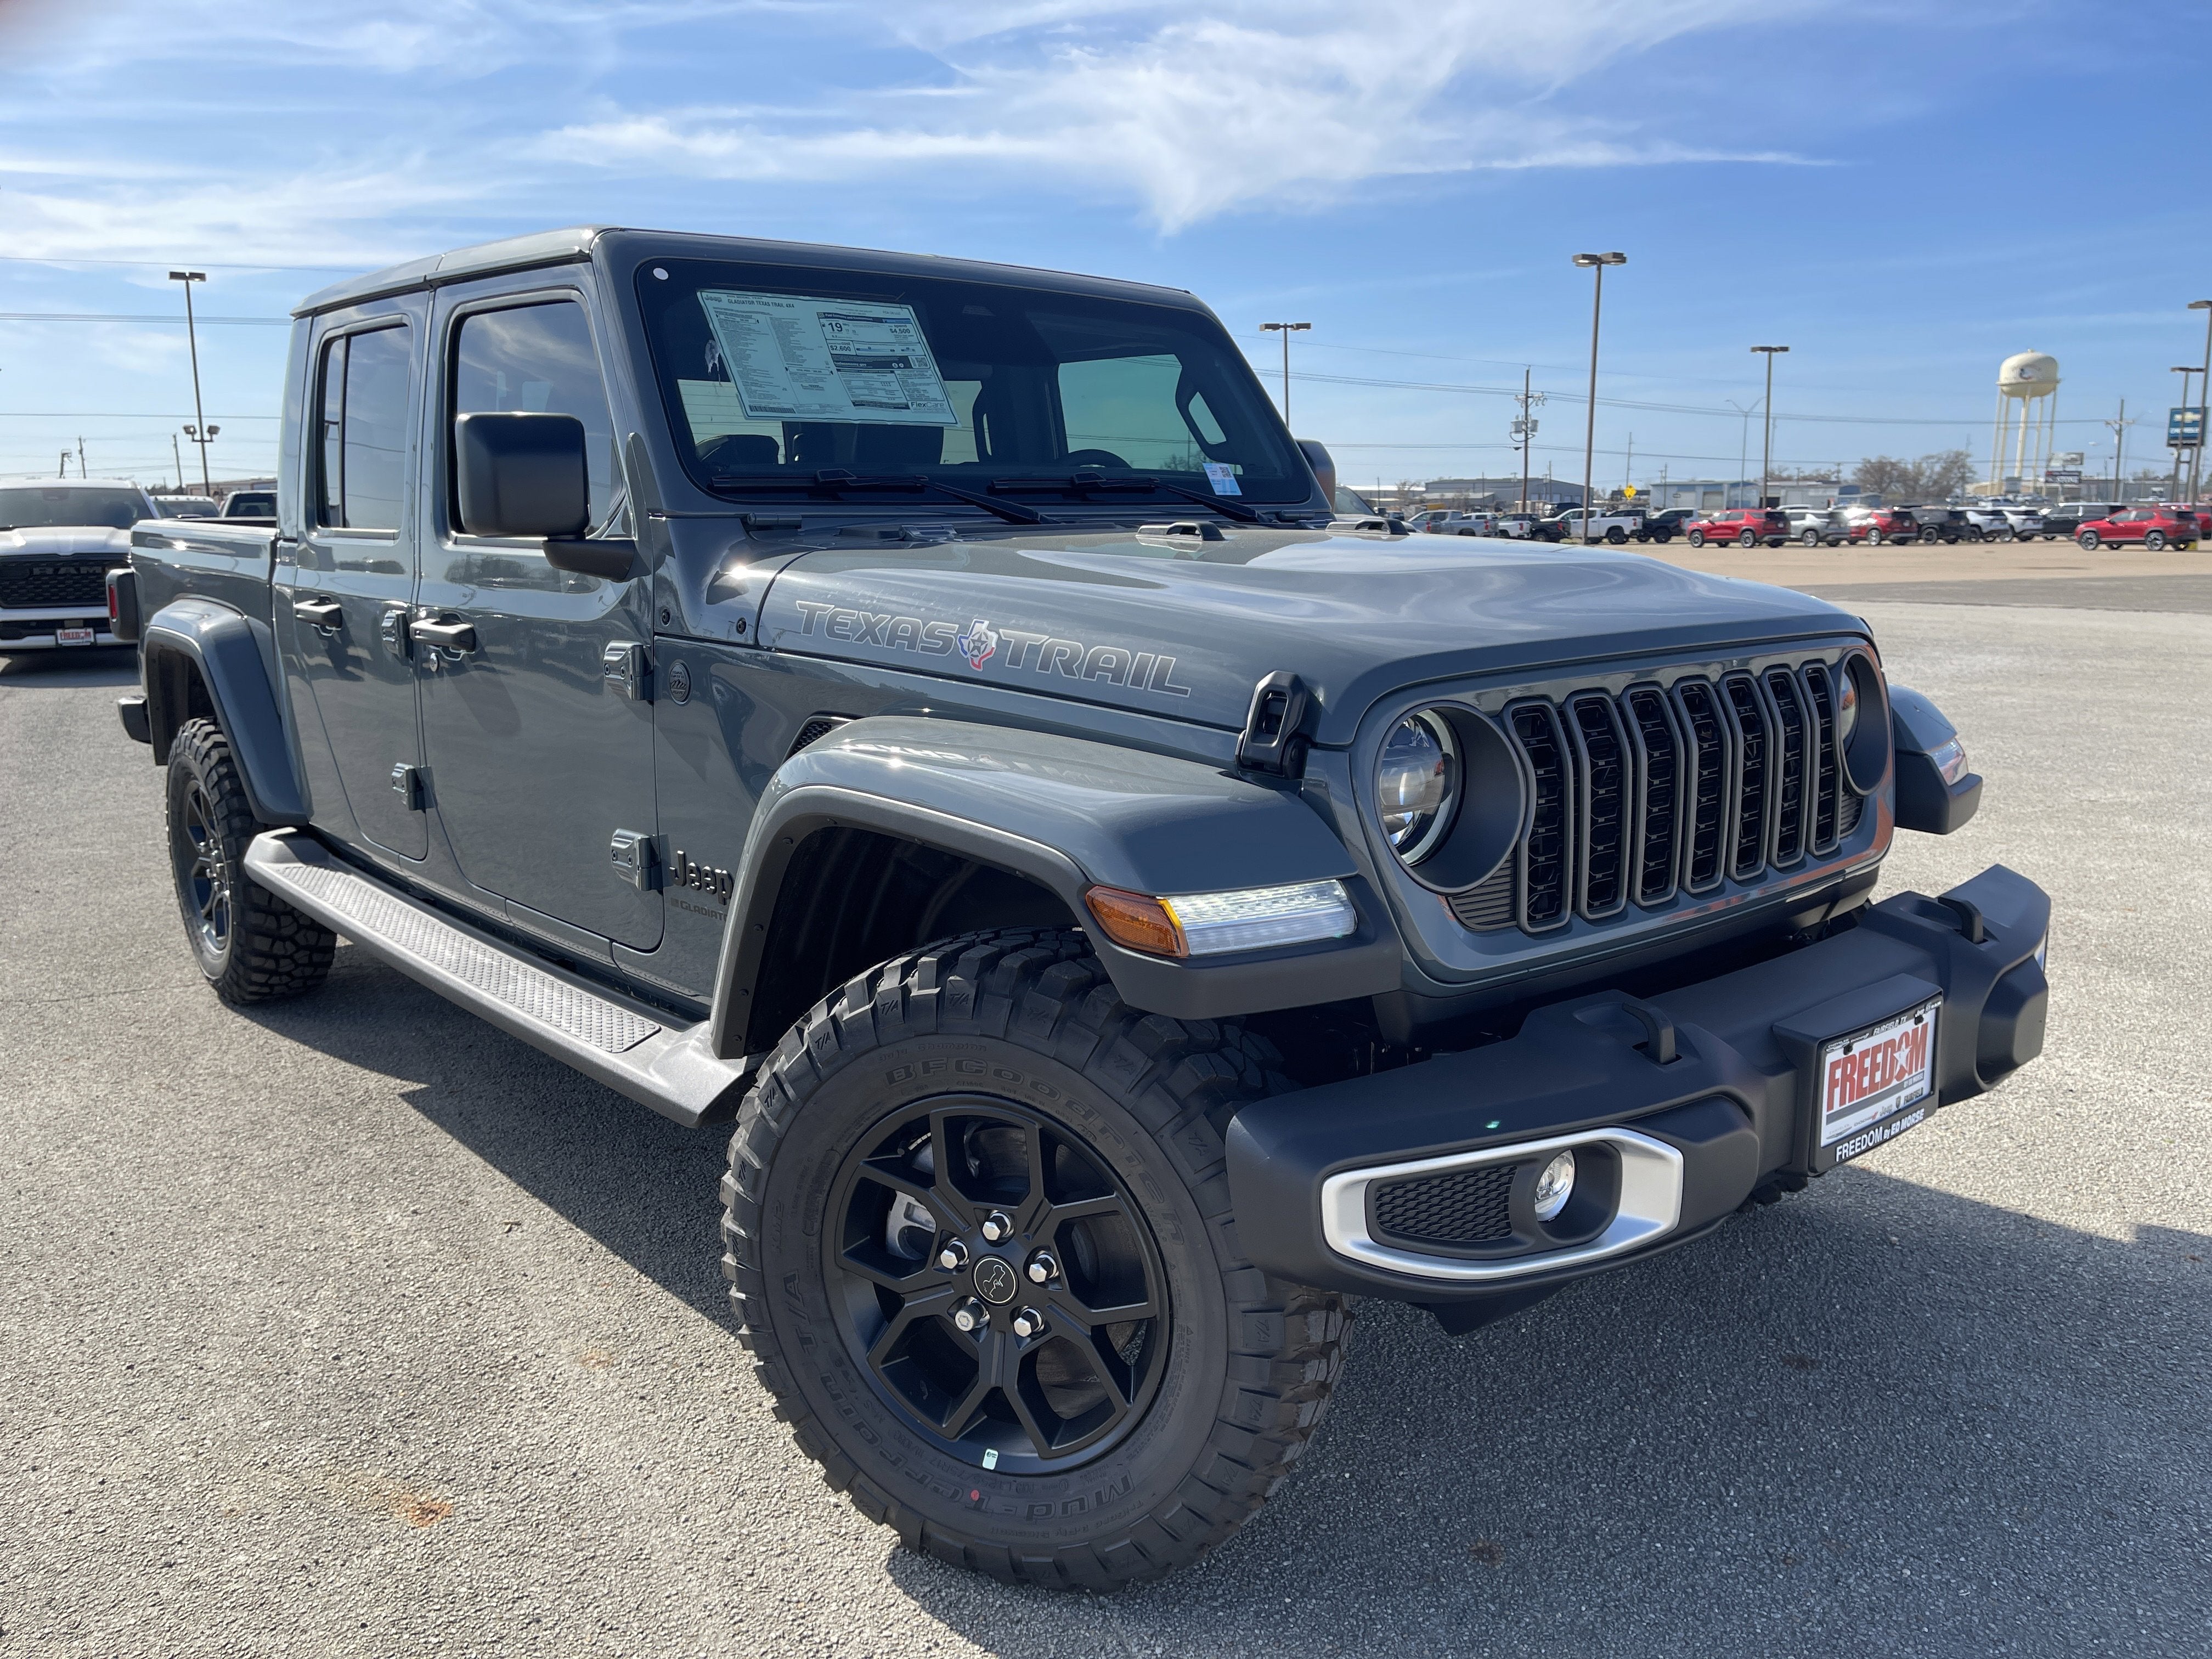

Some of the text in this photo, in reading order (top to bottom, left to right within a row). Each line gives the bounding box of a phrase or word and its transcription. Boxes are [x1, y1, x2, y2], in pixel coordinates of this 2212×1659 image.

[828, 322, 843, 332] 19
[33, 566, 102, 575] RAM
[796, 600, 960, 656] TEXAS
[998, 629, 1192, 698] TRAIL
[669, 850, 733, 905] Jeep
[881, 998, 899, 1016] T/A
[1900, 1015, 1908, 1025] TX
[815, 1031, 831, 1050] T/A
[917, 1042, 988, 1052] Champion
[1826, 1022, 1929, 1113] FREEDOM
[885, 1056, 1185, 1245] BFGoodrich
[1836, 1126, 1883, 1162] FREEDOM
[1891, 1120, 1900, 1136] ED
[1900, 1108, 1925, 1130] MORSE
[783, 1269, 818, 1357] T/A
[819, 1372, 1136, 1525] Mud-Terrain
